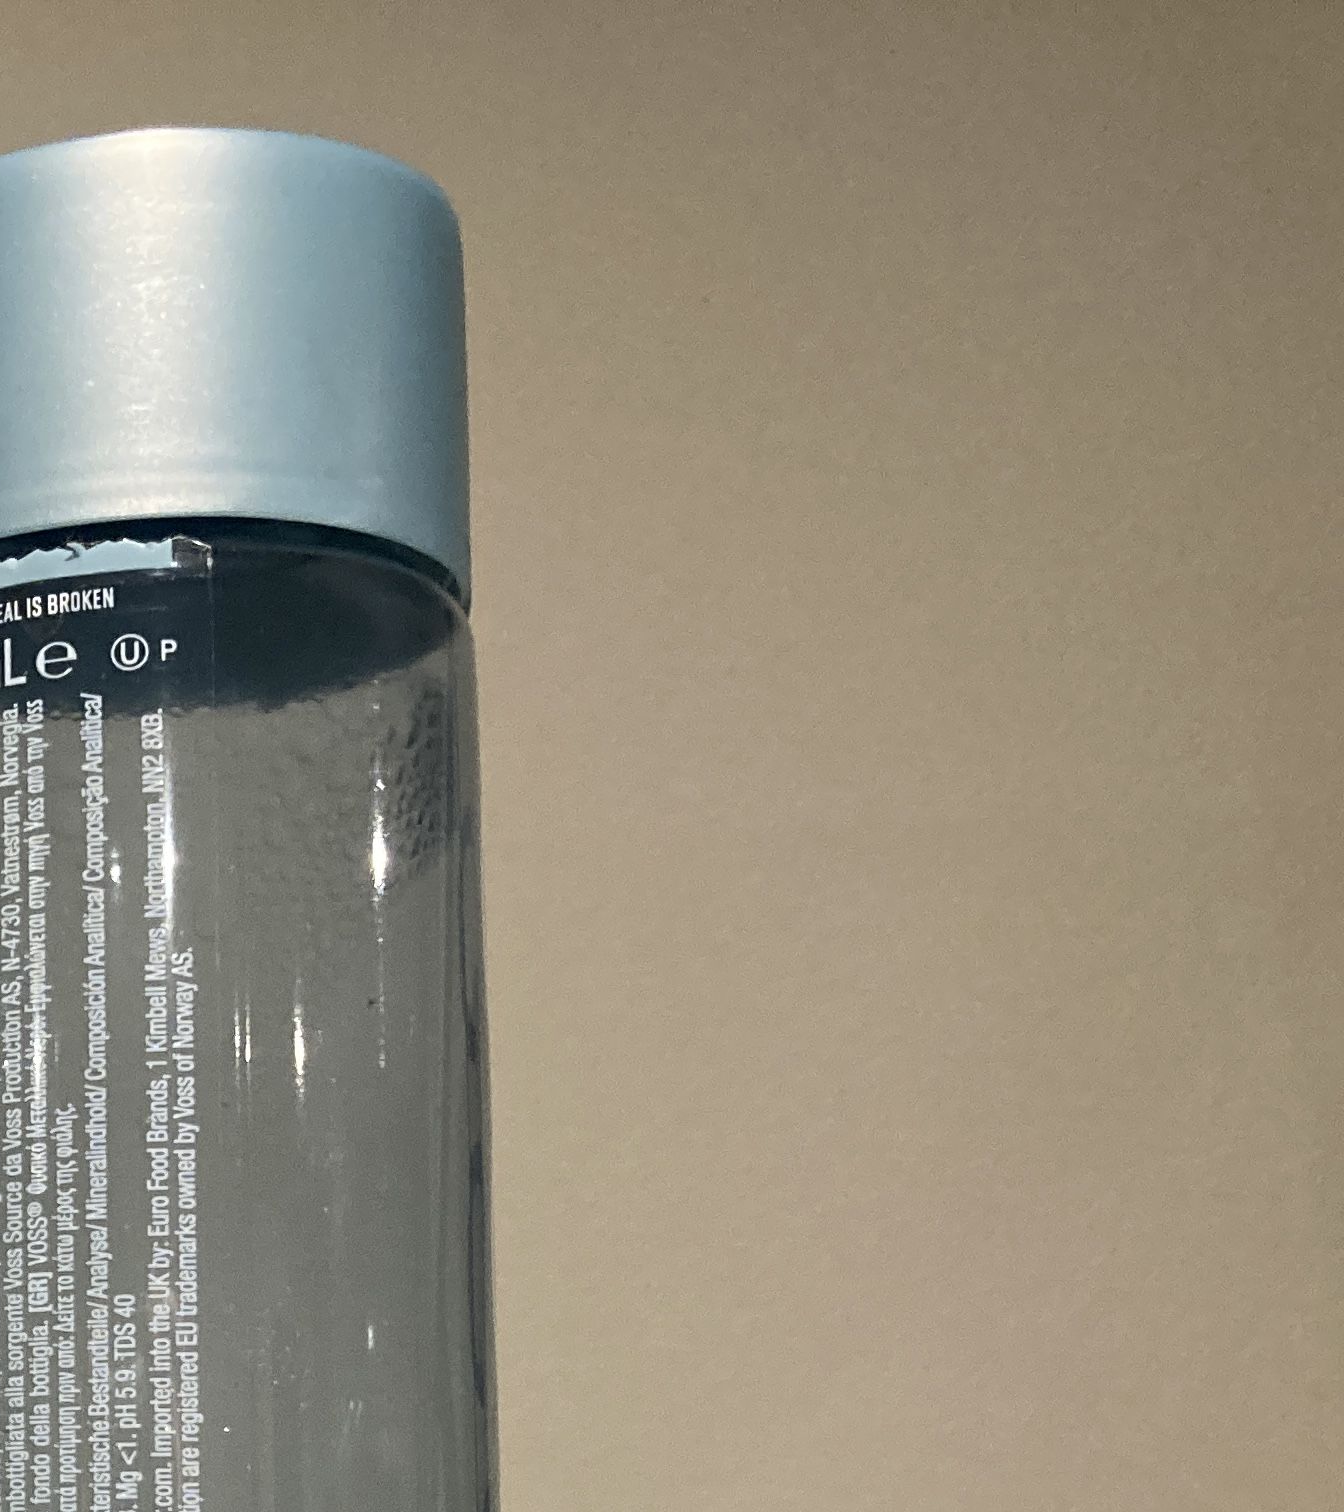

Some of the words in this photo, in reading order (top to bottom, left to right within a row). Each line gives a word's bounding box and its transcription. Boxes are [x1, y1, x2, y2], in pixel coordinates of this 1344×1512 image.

[26, 596, 42, 619] IS
[47, 586, 115, 616] BROKEN
[142, 754, 164, 793] NN2
[171, 947, 194, 977] AS.
[83, 969, 111, 1081] Composición
[144, 987, 168, 1052] Kimbell
[172, 981, 199, 1049] Norway
[172, 1053, 195, 1072] of
[146, 1074, 172, 1142] Brands,
[173, 1077, 195, 1118] Voss
[84, 1084, 108, 1219] Mineralindhold/
[173, 1122, 200, 1143] by
[146, 1148, 169, 1191] Food
[174, 1149, 196, 1209] owned
[147, 1196, 169, 1237] Euro
[85, 1224, 113, 1299] Analyse/
[148, 1241, 174, 1268] by:
[174, 1214, 197, 1315] trademarks
[148, 1274, 169, 1298] UK
[114, 1294, 136, 1318] 40
[148, 1304, 171, 1333] the
[114, 1323, 136, 1361] TDS
[176, 1323, 198, 1346] EU
[86, 1302, 110, 1416] Bestandteile/
[148, 1338, 171, 1371] into
[115, 1404, 142, 1428] pH
[176, 1352, 204, 1442] registered
[150, 1378, 177, 1457] Imported
[182, 1448, 199, 1477] are
[116, 1471, 143, 1499] Mg
